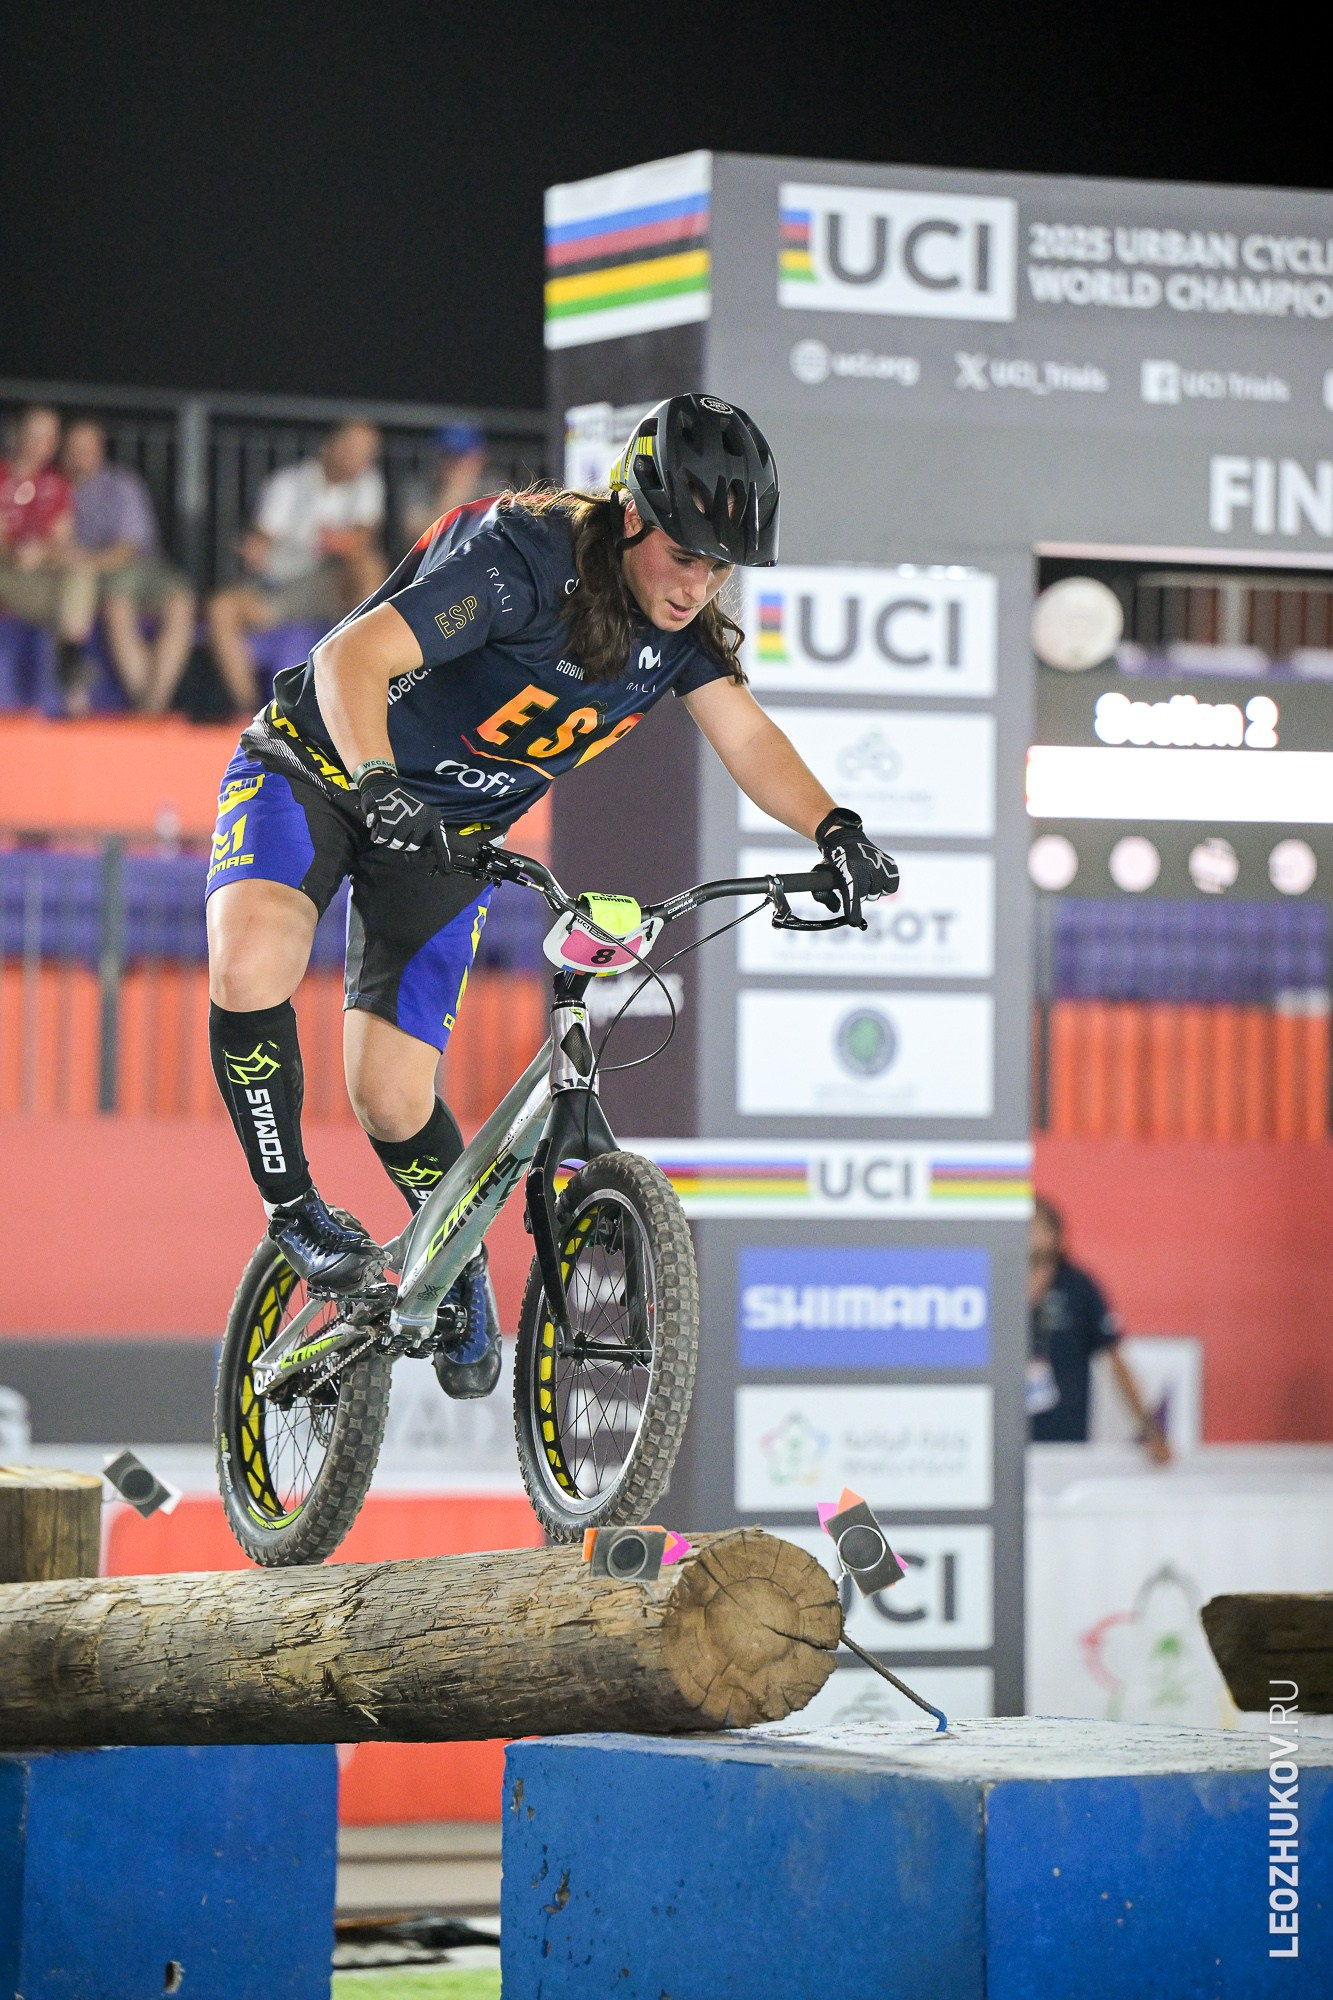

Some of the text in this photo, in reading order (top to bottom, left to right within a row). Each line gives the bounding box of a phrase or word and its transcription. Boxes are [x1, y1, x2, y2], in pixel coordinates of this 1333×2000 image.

[828, 213, 990, 292] UCI
[1028, 222, 1111, 262] 2025
[1114, 227, 1239, 270] URBAN
[1028, 264, 1162, 308] WORLD
[1210, 455, 1333, 536] FIN
[434, 595, 477, 639] ESP
[799, 595, 960, 666] UCI
[1244, 696, 1279, 748] 2
[591, 949, 616, 964] 8
[245, 1088, 287, 1174] COMAS
[820, 1160, 911, 1200] UCI
[744, 1284, 984, 1330] SHIMANO
